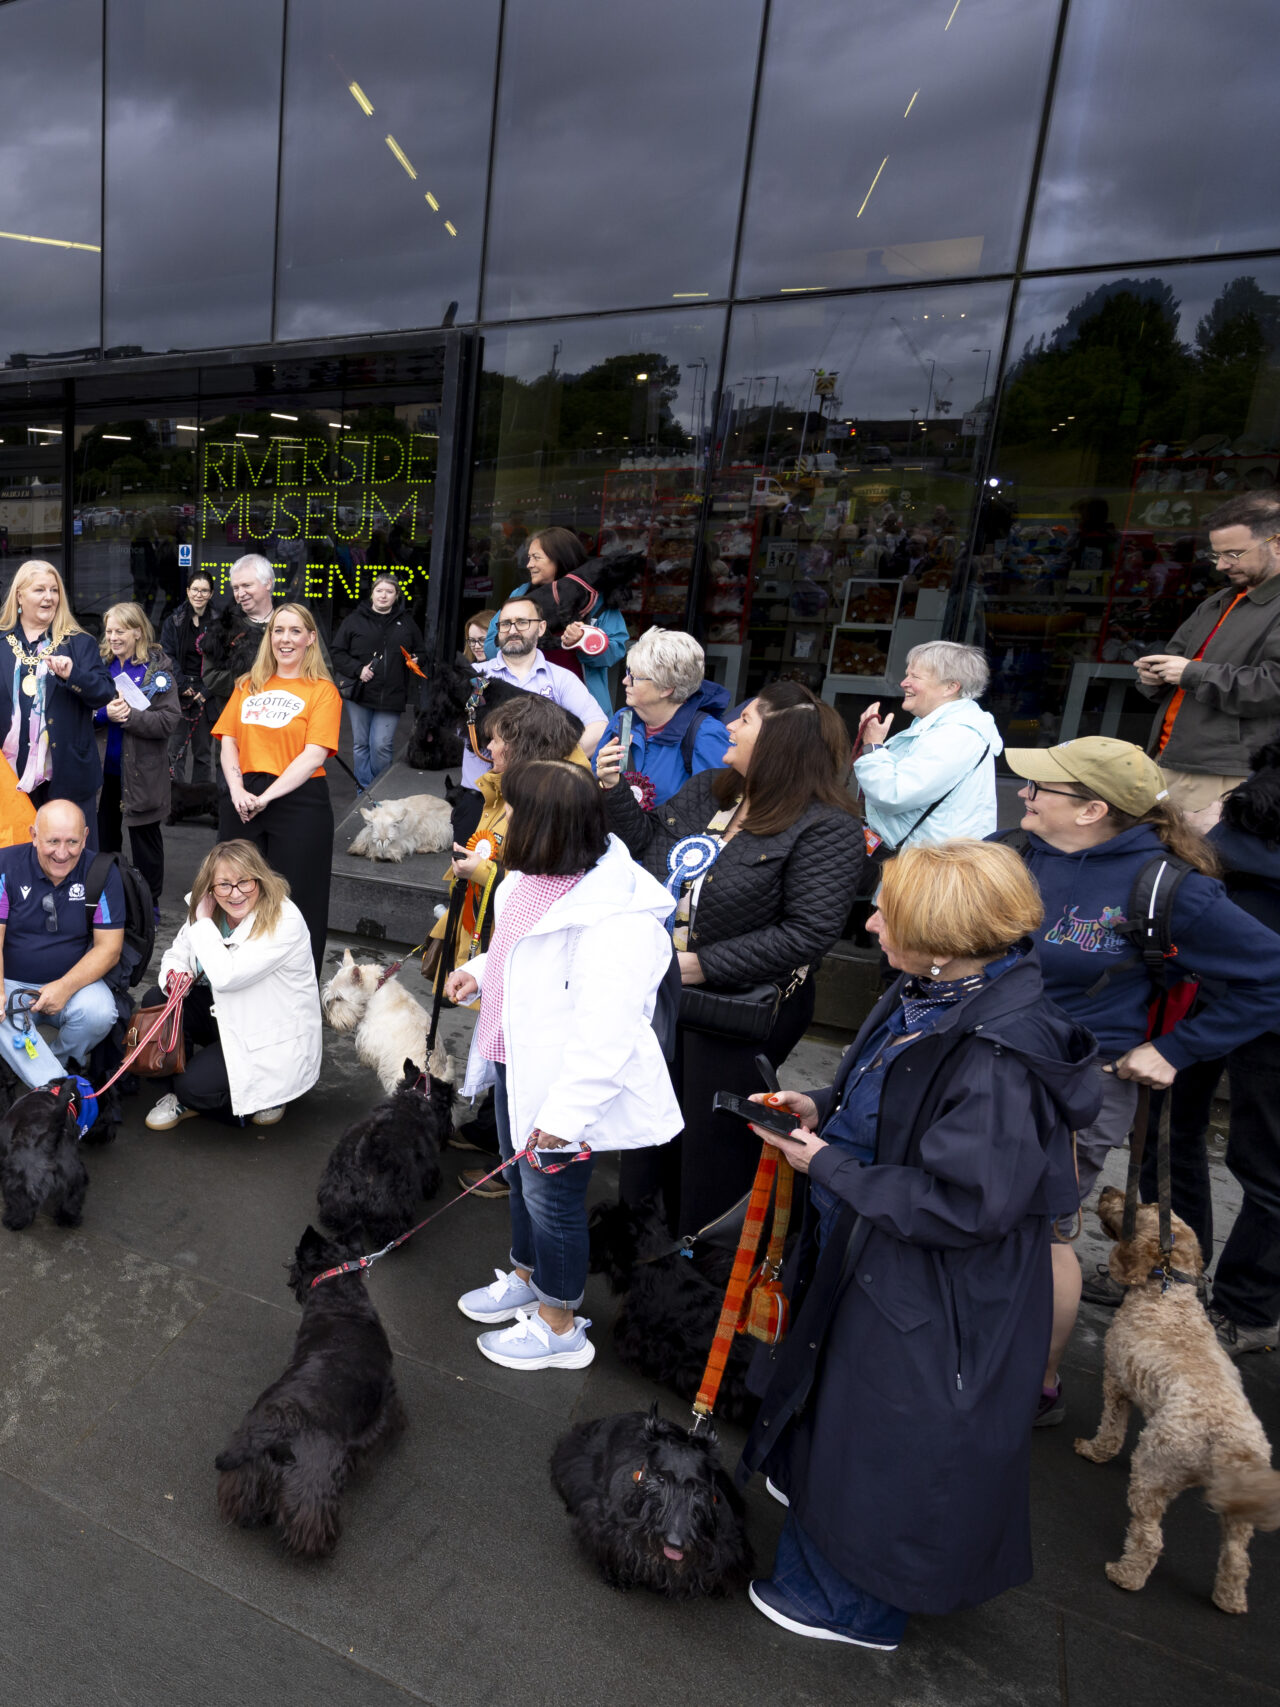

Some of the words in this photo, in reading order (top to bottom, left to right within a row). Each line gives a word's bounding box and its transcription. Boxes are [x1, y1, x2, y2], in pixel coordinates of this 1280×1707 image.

[203, 433, 439, 488] RIVERSIDE
[201, 490, 418, 540] MUSEUM
[247, 697, 301, 711] SCOTTIES
[265, 710, 290, 720] CITY
